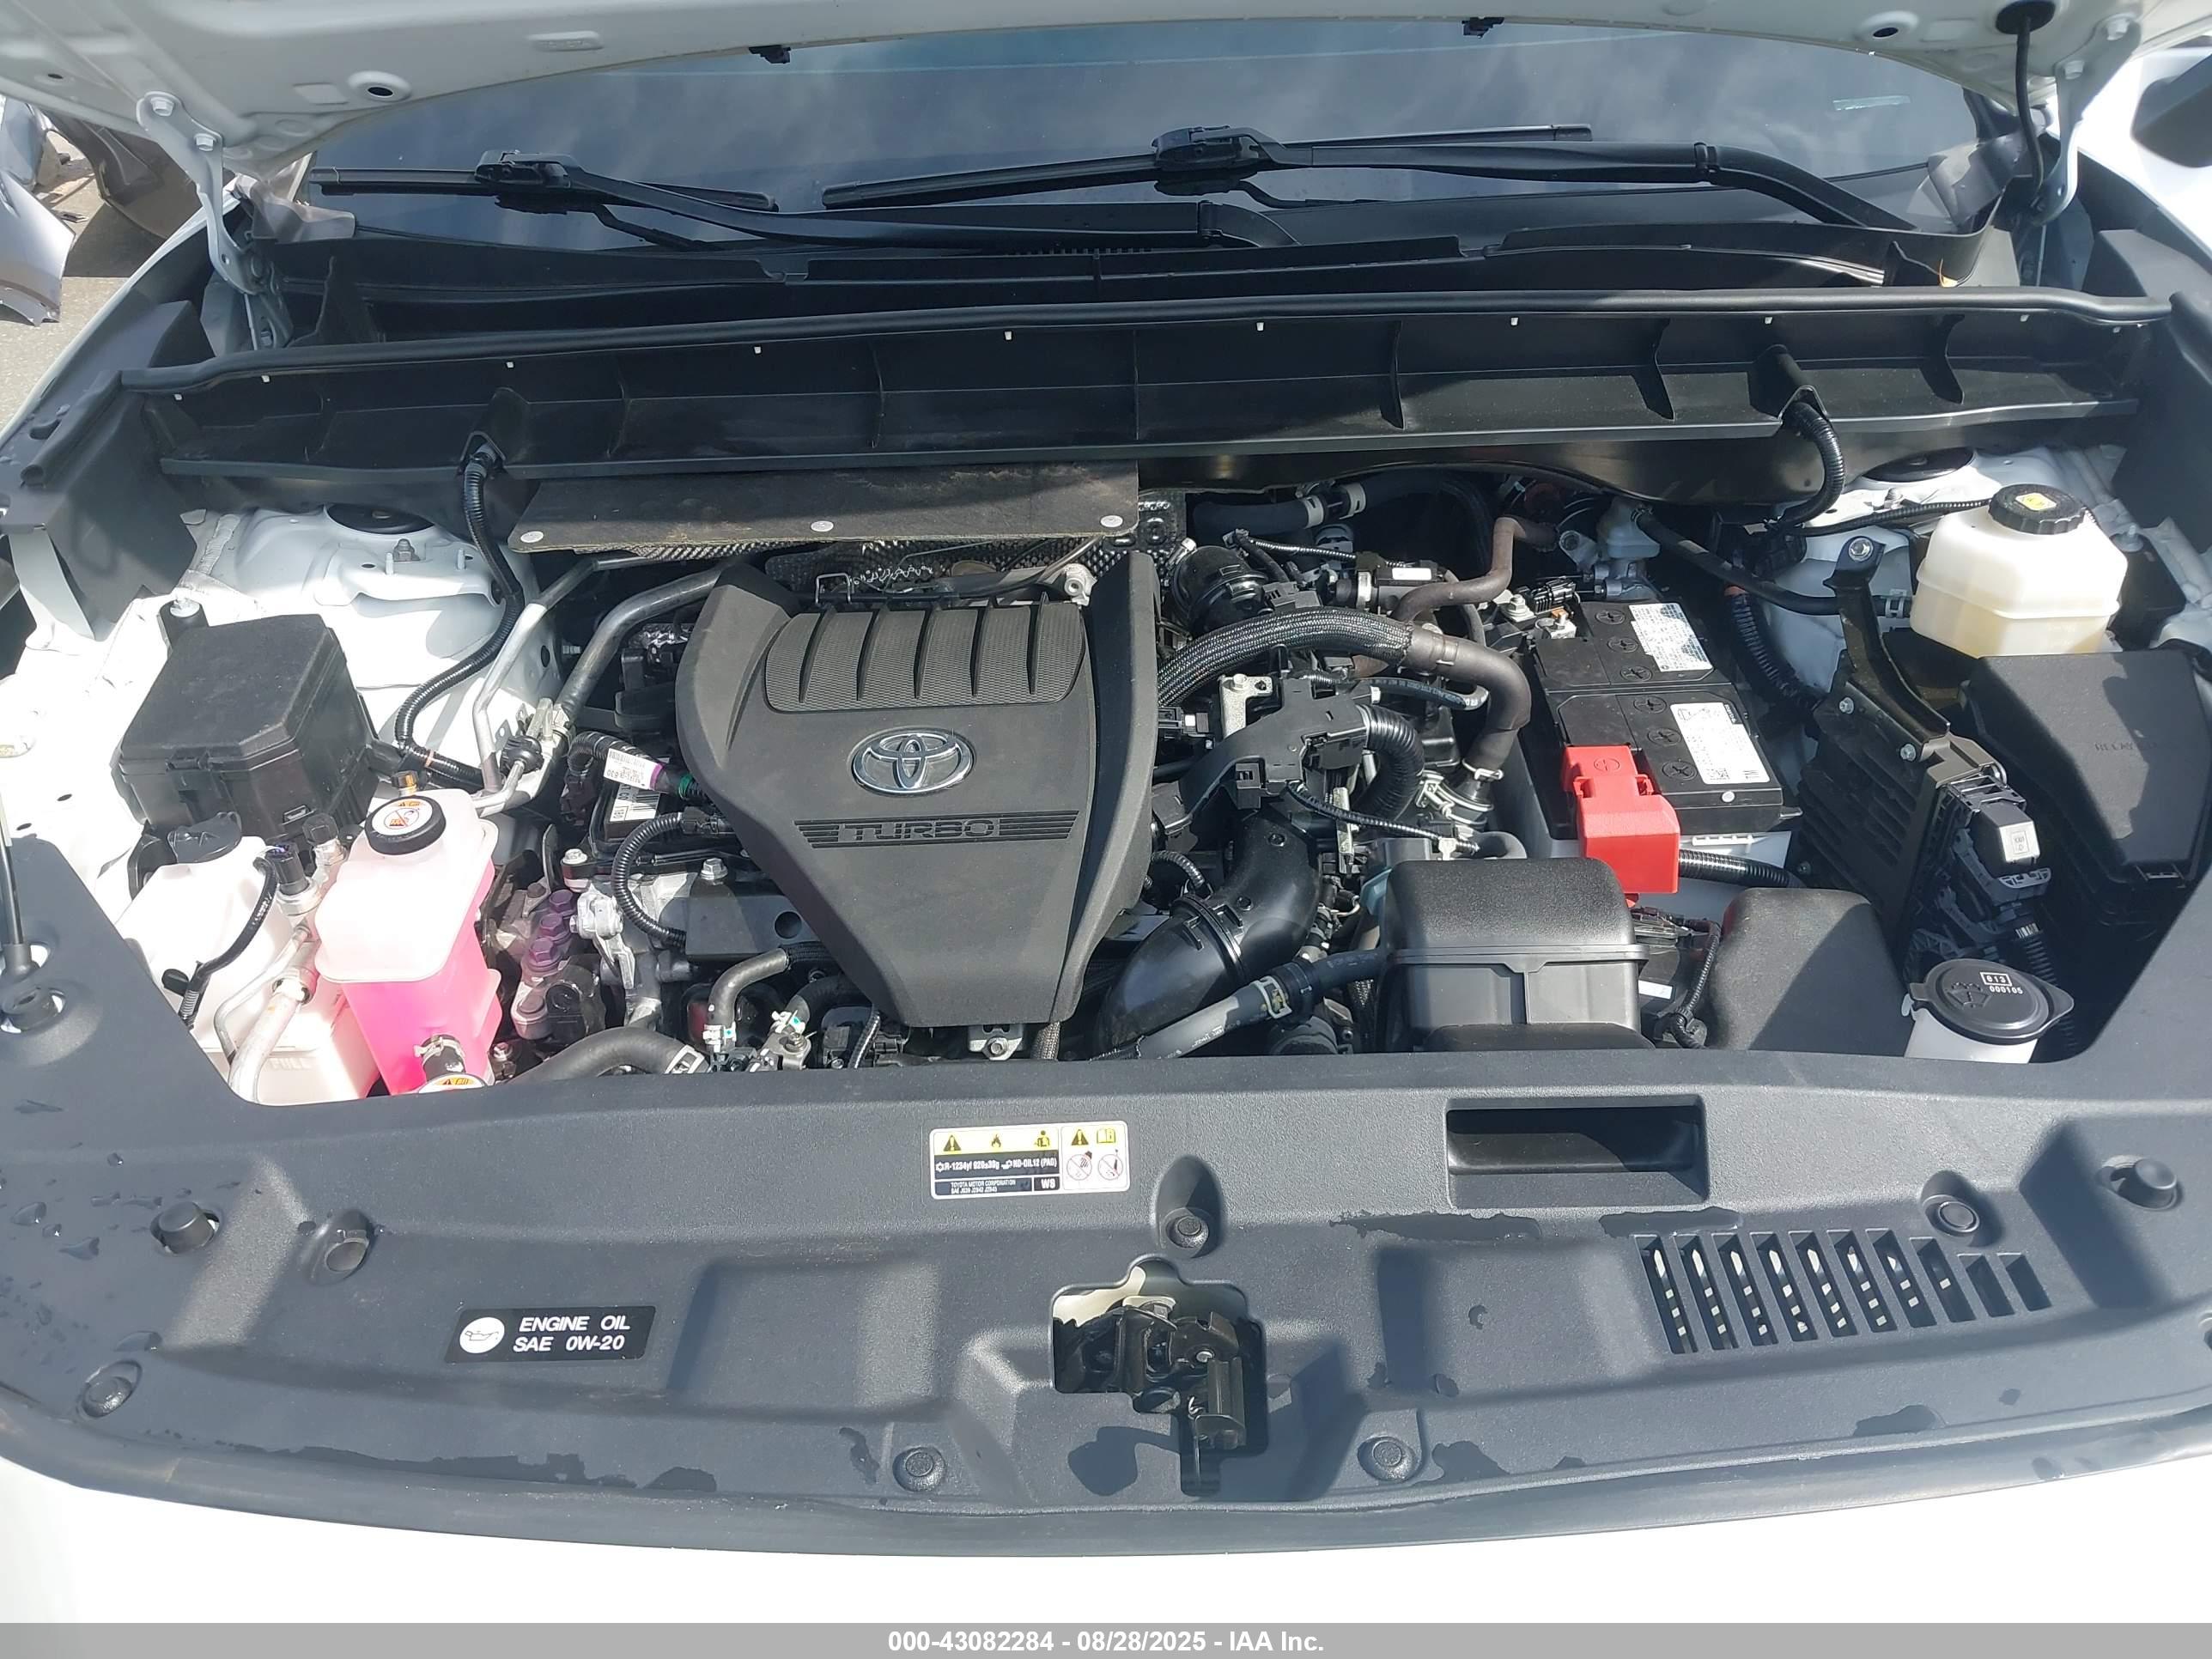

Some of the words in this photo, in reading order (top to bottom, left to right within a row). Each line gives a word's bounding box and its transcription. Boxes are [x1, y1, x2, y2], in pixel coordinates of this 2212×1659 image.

[843, 819, 994, 841] TURBO
[519, 1316, 590, 1332] ENGINE
[600, 1315, 630, 1331] OIL
[513, 1336, 554, 1352] SAE
[565, 1335, 625, 1352] 0W-20
